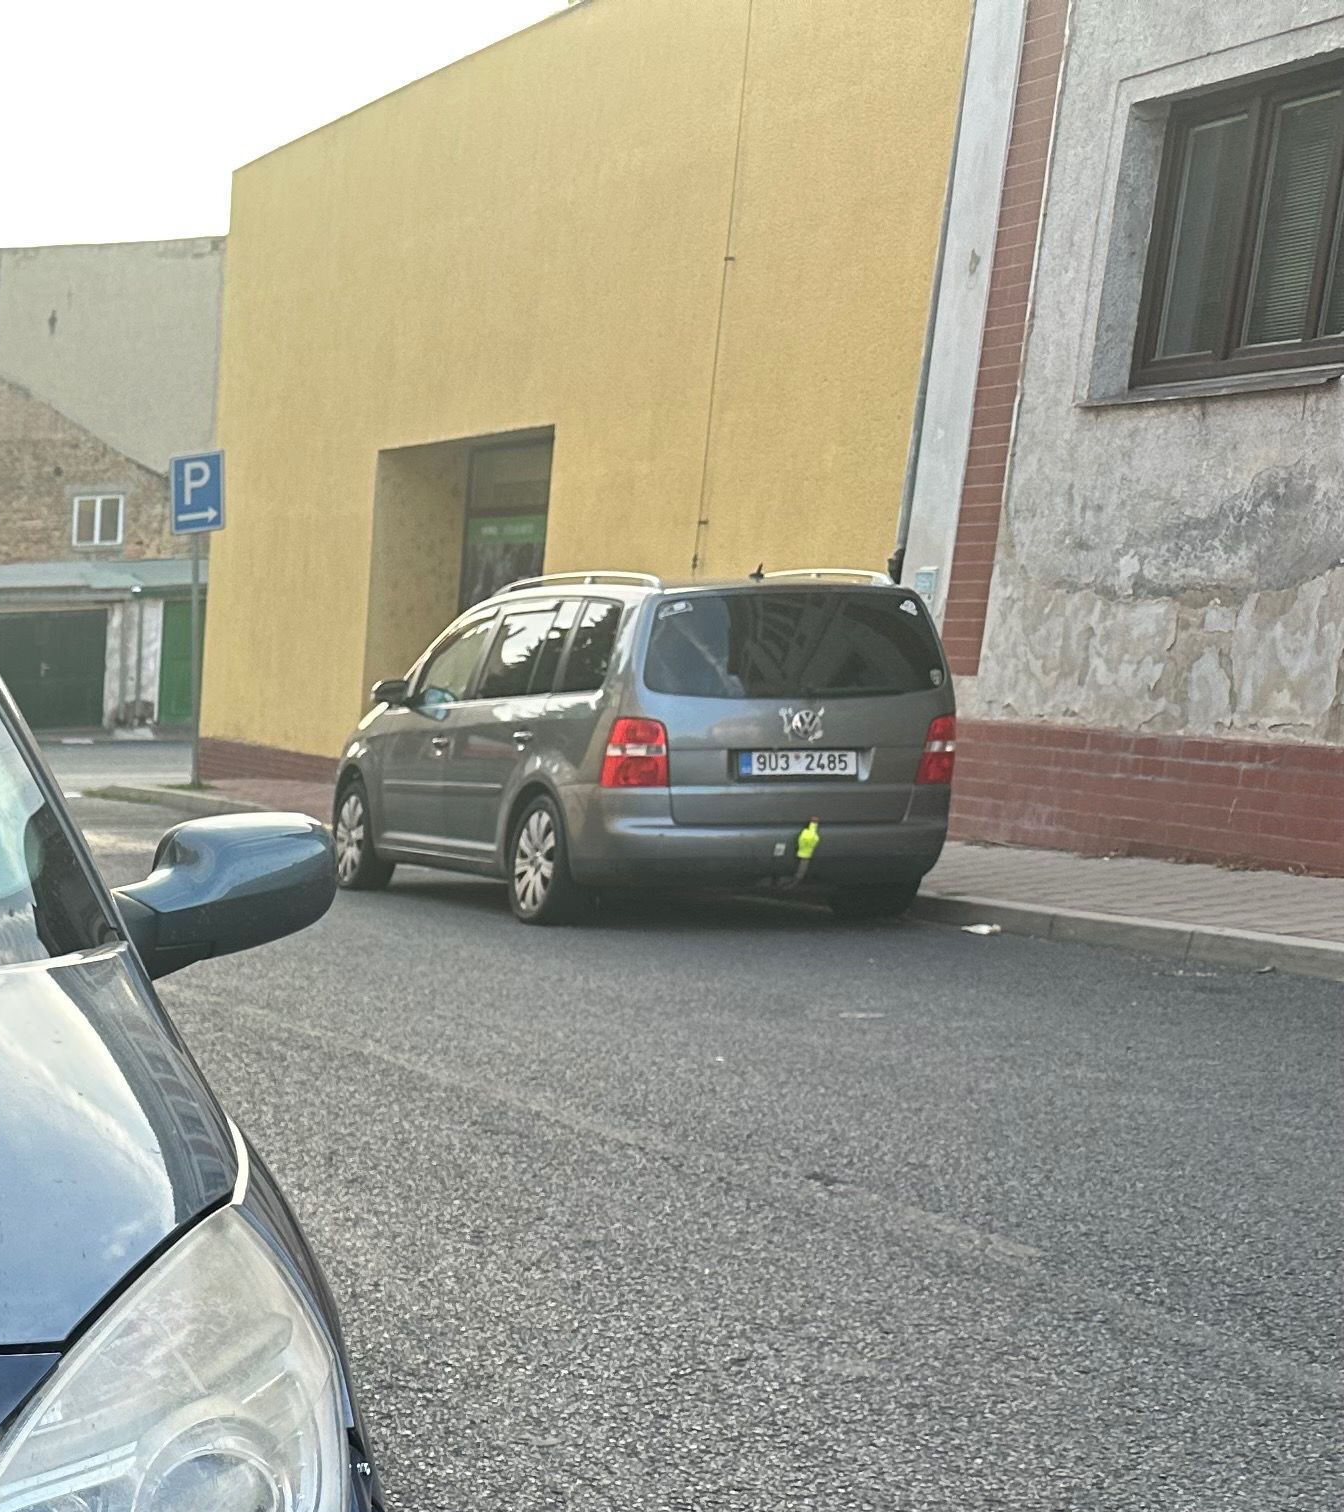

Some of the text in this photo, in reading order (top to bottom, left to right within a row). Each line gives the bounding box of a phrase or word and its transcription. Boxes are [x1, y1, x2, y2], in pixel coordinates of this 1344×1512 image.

[183, 460, 211, 505] P
[756, 753, 790, 771] 9U3
[805, 752, 848, 771] 2485
